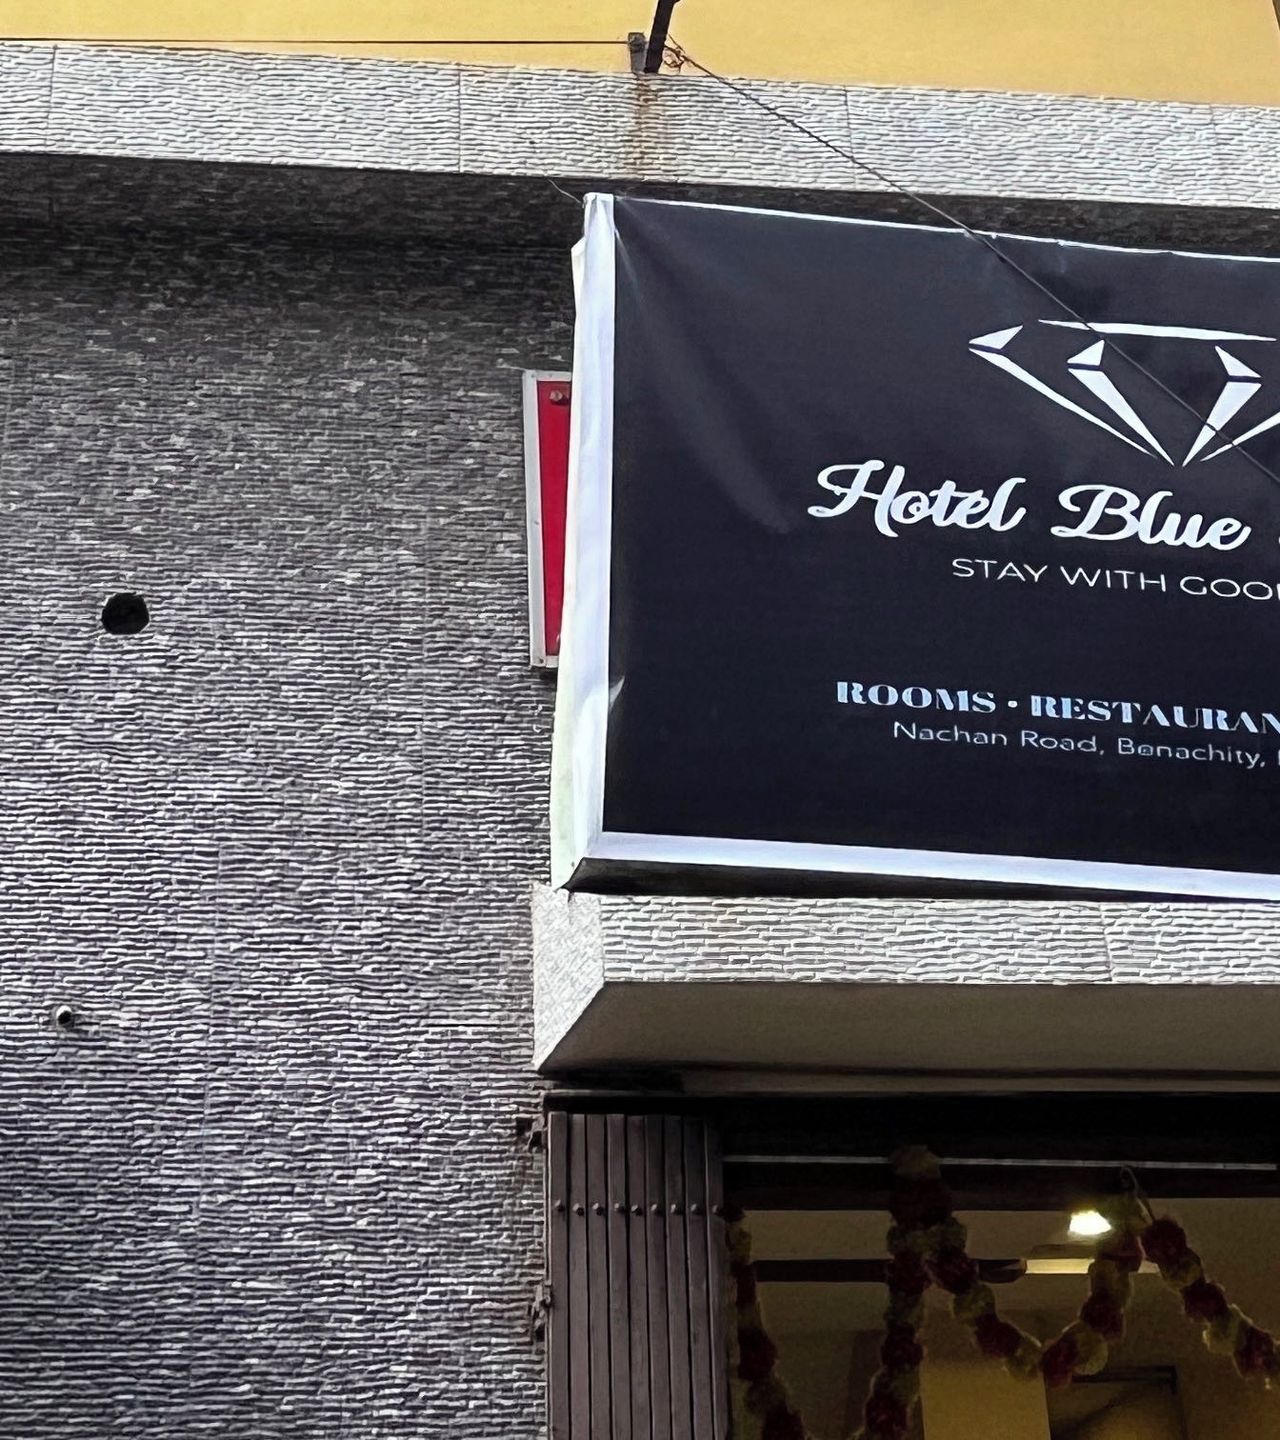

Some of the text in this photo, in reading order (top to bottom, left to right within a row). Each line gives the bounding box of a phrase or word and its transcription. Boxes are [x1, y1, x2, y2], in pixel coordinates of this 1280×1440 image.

[807, 459, 1027, 538] Hotel
[1050, 484, 1252, 551] Blue
[951, 558, 1048, 582] STAY
[1059, 565, 1167, 593] WITH
[836, 681, 996, 714] ROOMS
[893, 721, 1008, 747] Nachan
[1021, 729, 1106, 756] Road,
[1117, 737, 1267, 770] Benachity,
